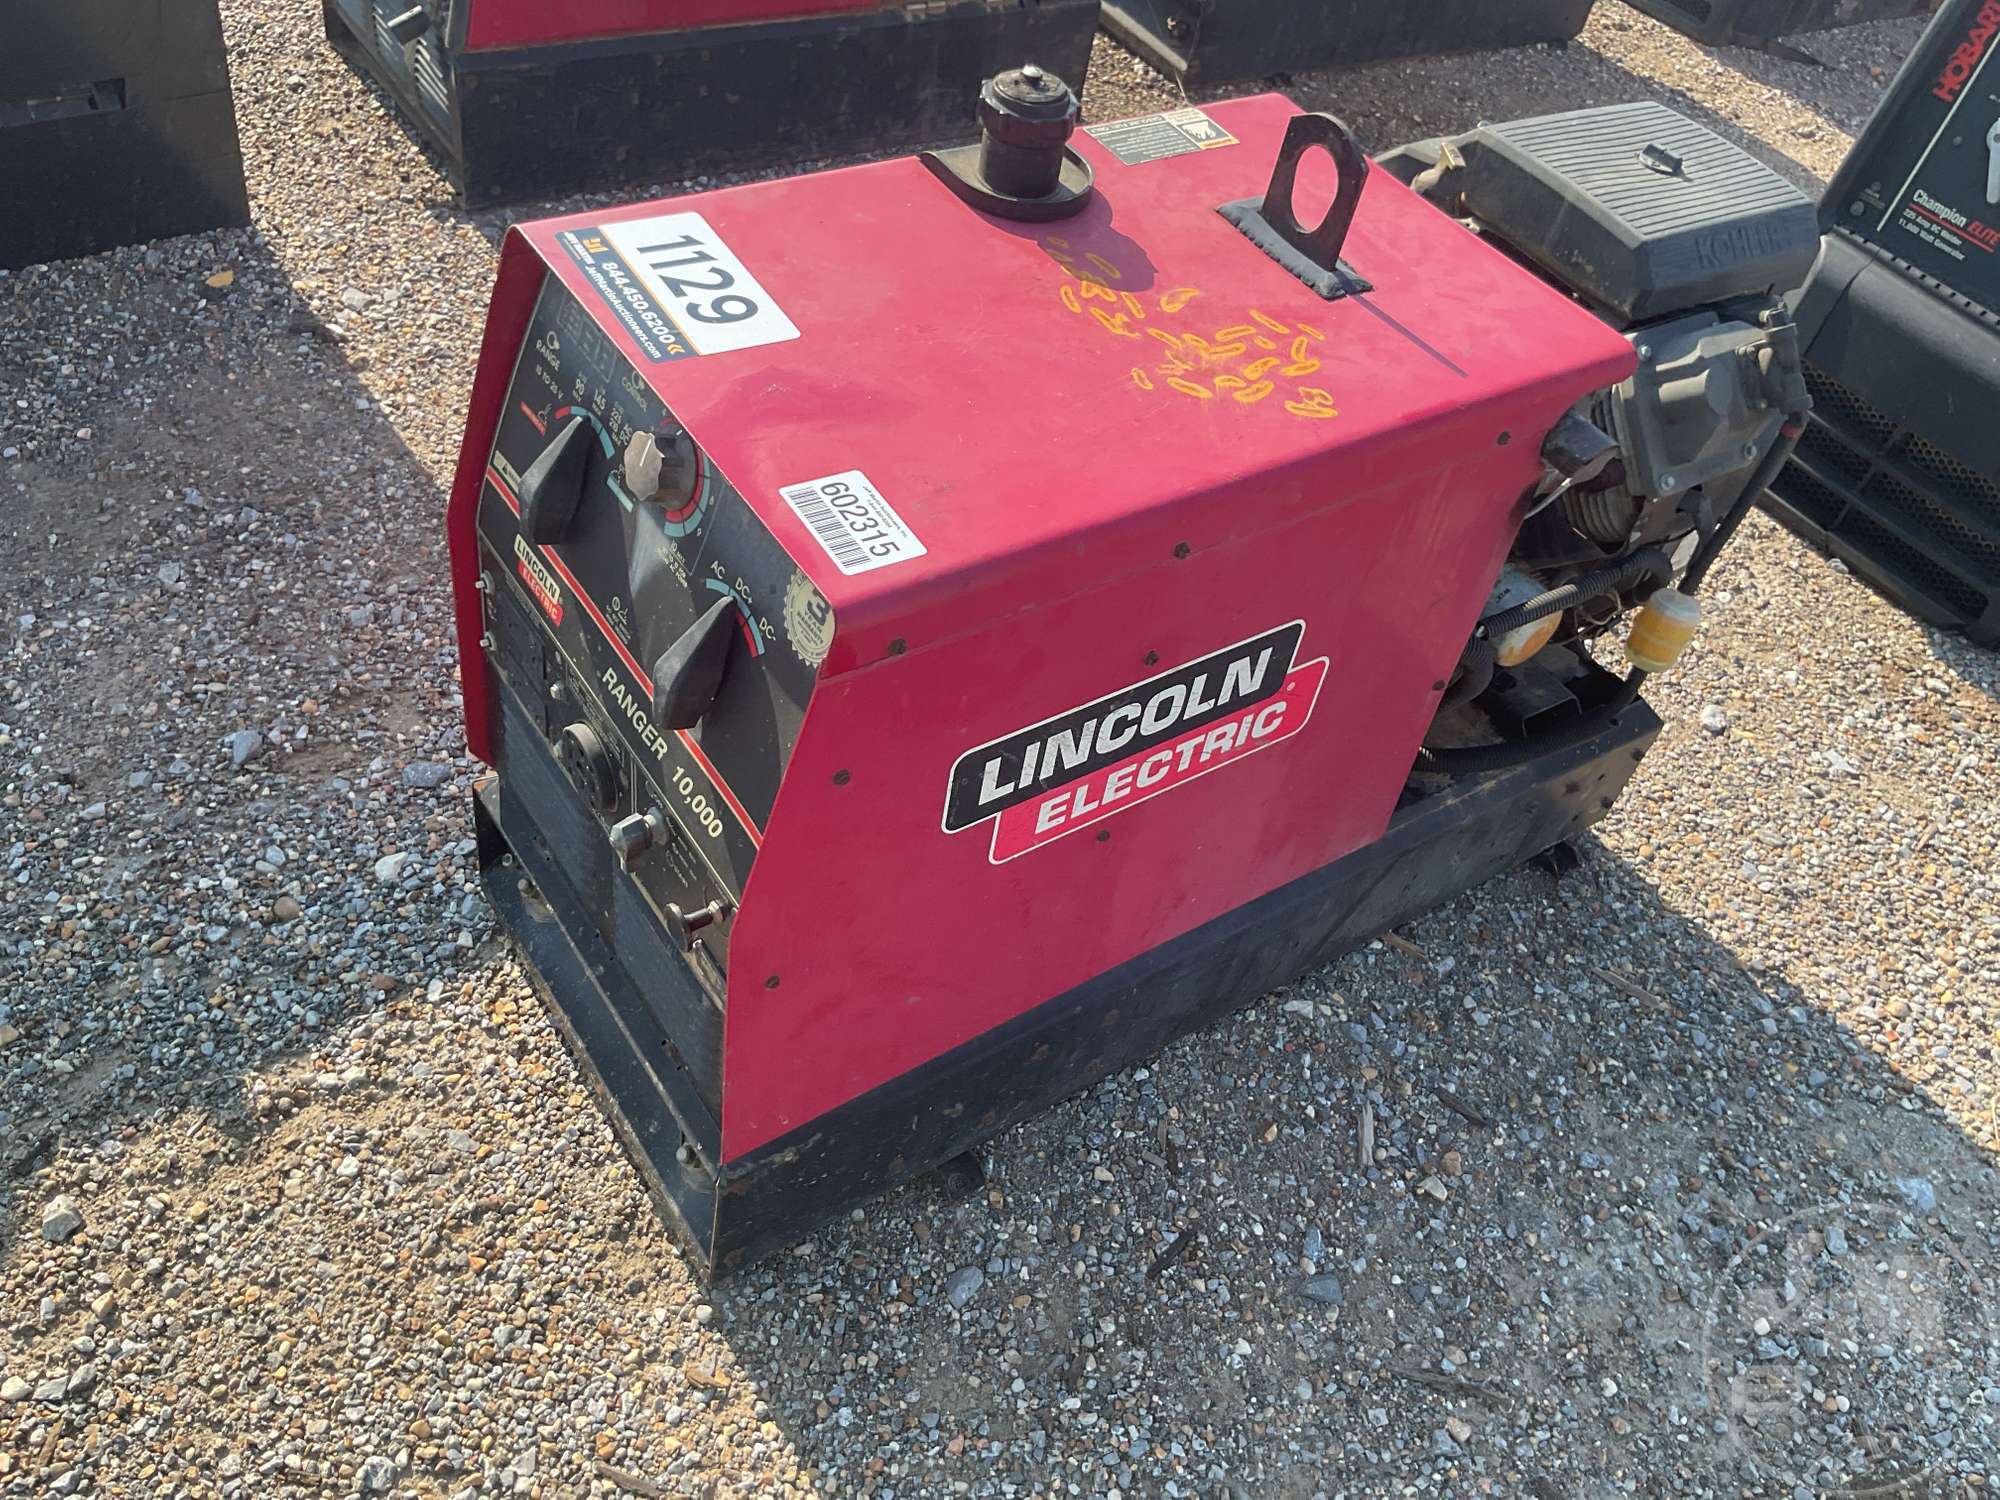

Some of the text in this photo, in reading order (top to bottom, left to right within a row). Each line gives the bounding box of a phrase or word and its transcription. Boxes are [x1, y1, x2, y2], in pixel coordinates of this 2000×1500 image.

[1913, 189, 1967, 228] Champion
[1967, 220, 2000, 248] ELITE
[1934, 238, 1966, 260] Generator
[585, 264, 662, 359] JeffMartinAuctioneers.com
[602, 262, 675, 344] 844.450.6200
[636, 234, 759, 325] 1129
[536, 339, 560, 372] RANGE
[820, 481, 901, 557] 602315
[517, 539, 557, 602] LINCOLN
[522, 566, 558, 620] ELECTRIC
[710, 560, 726, 580] AC
[602, 667, 668, 760] RANGER
[672, 765, 723, 838] 10,000
[977, 647, 1273, 806] LINCOLN
[1034, 701, 1288, 834] ELECTRIC
